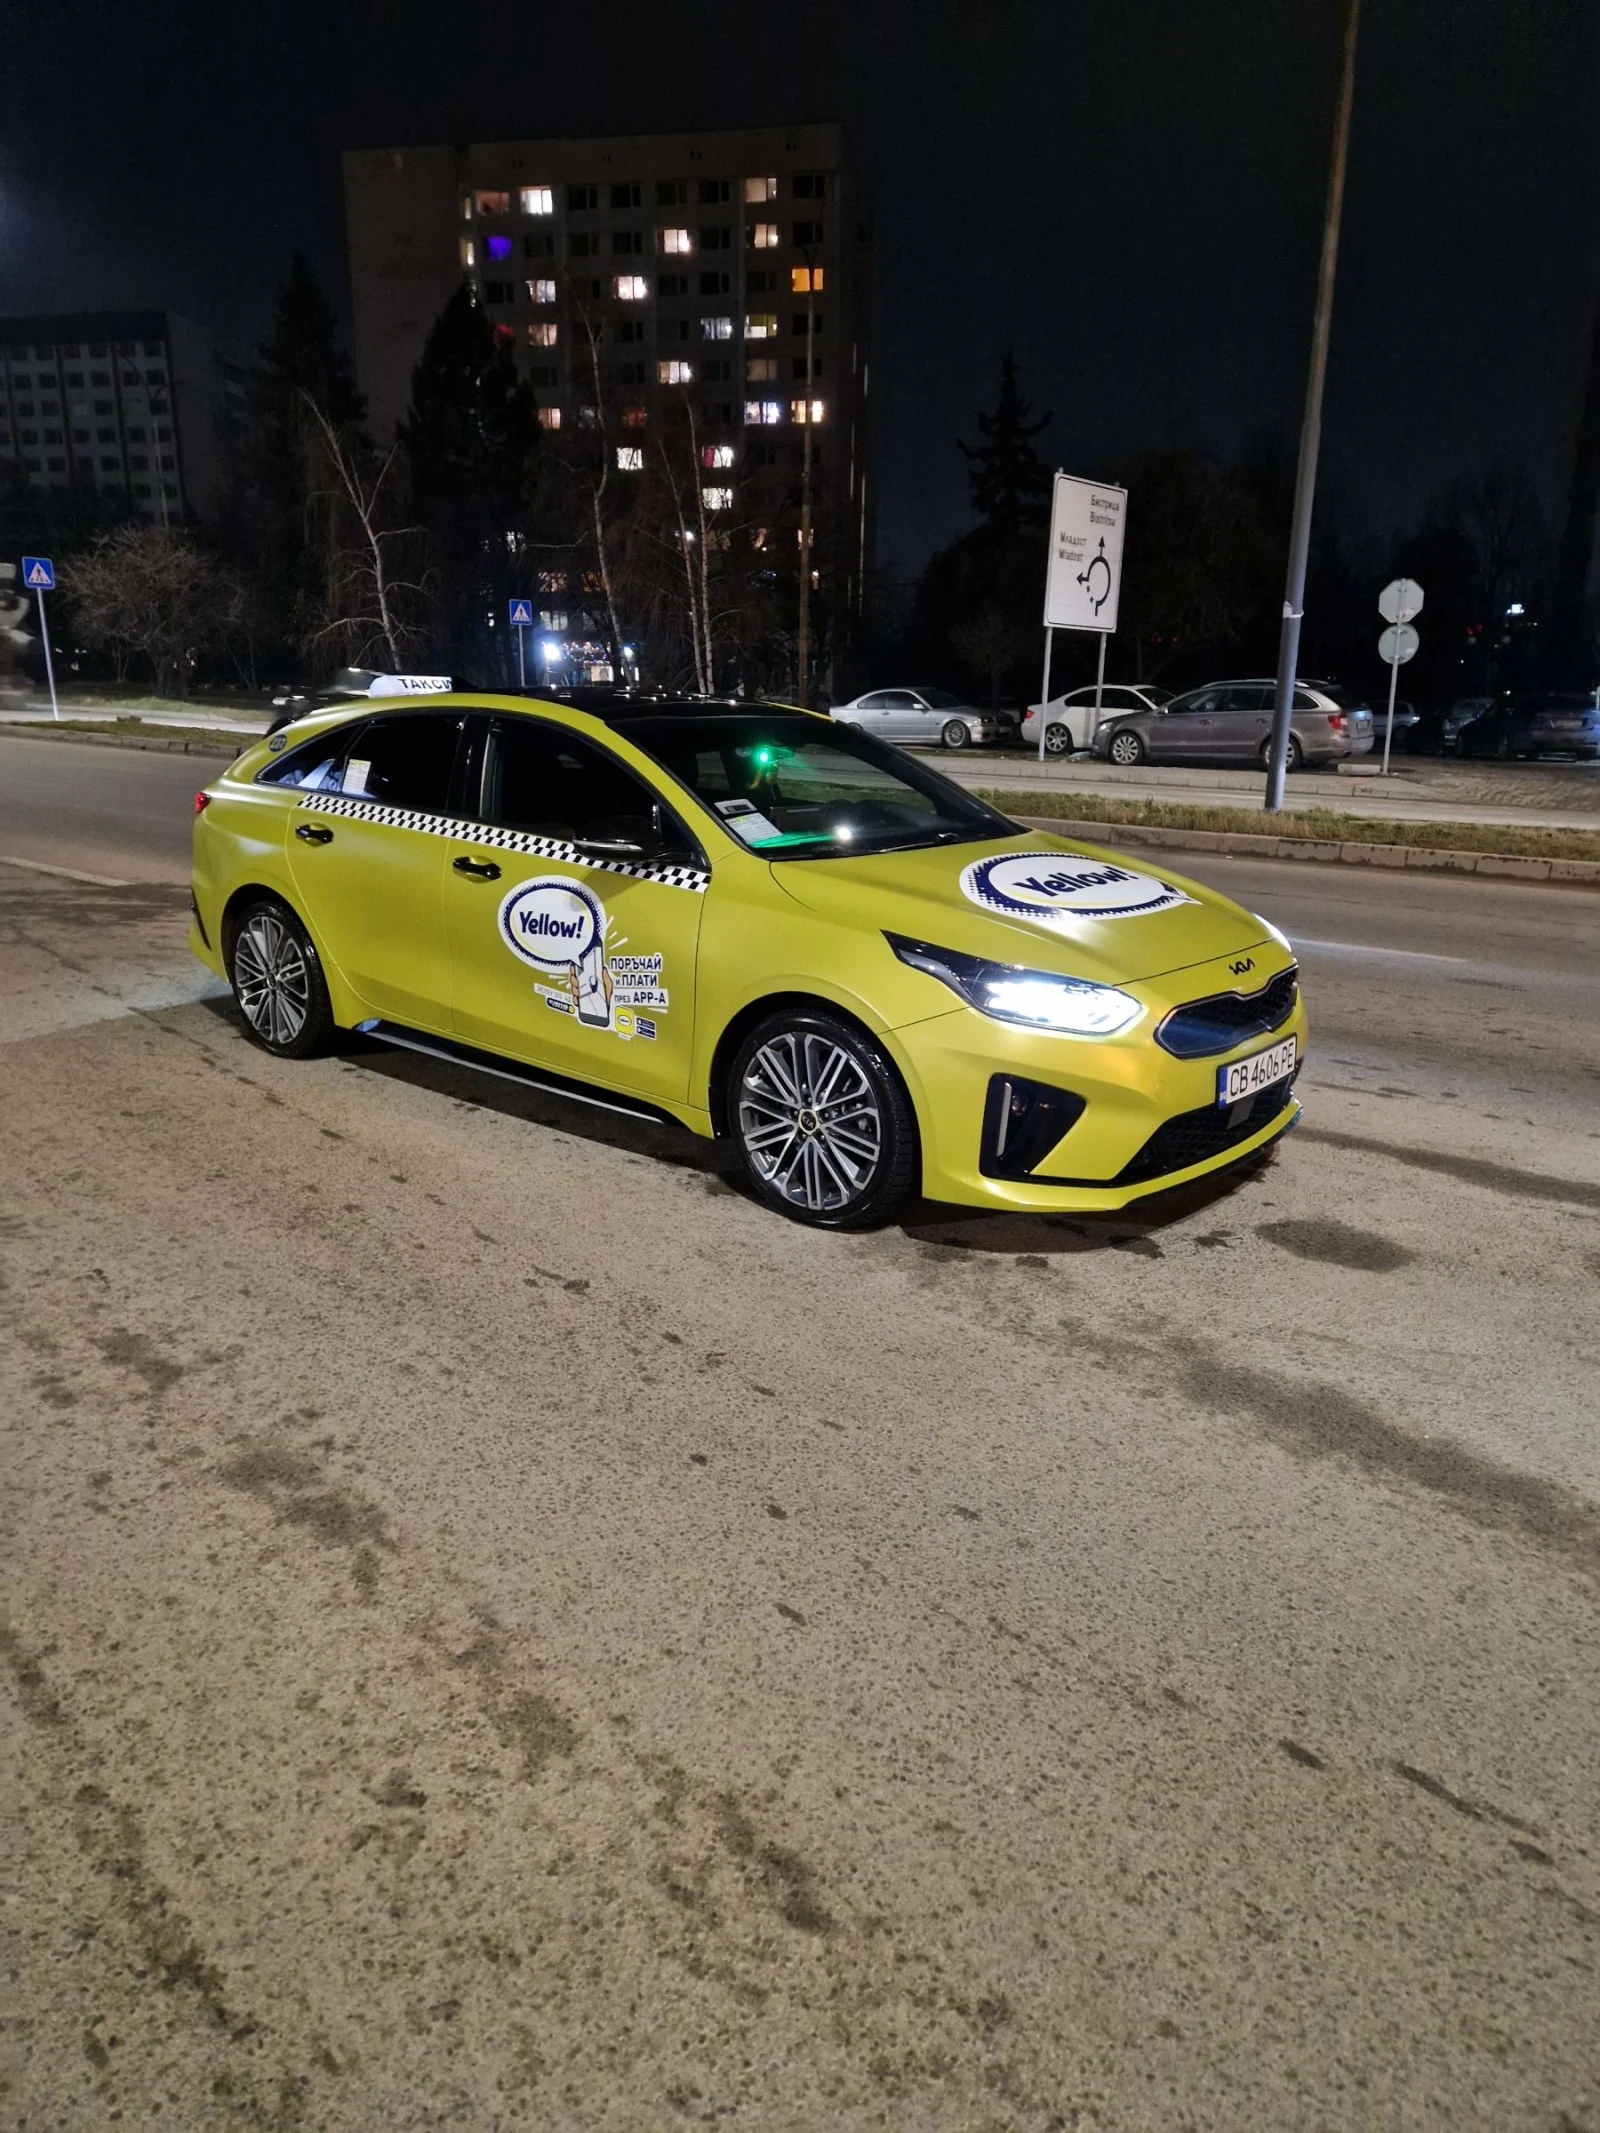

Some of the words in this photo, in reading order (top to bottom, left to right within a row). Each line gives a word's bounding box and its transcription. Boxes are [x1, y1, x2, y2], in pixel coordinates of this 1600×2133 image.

[1059, 548, 1083, 562] Mladost
[397, 678, 453, 690] ТАКСИ
[1012, 866, 1139, 897] Yellow!
[519, 910, 585, 939] Yellow!
[610, 954, 662, 970] ПОРЪЧАЙ
[622, 974, 657, 987] ПЛАТИ
[1251, 1049, 1279, 1088] 4606
